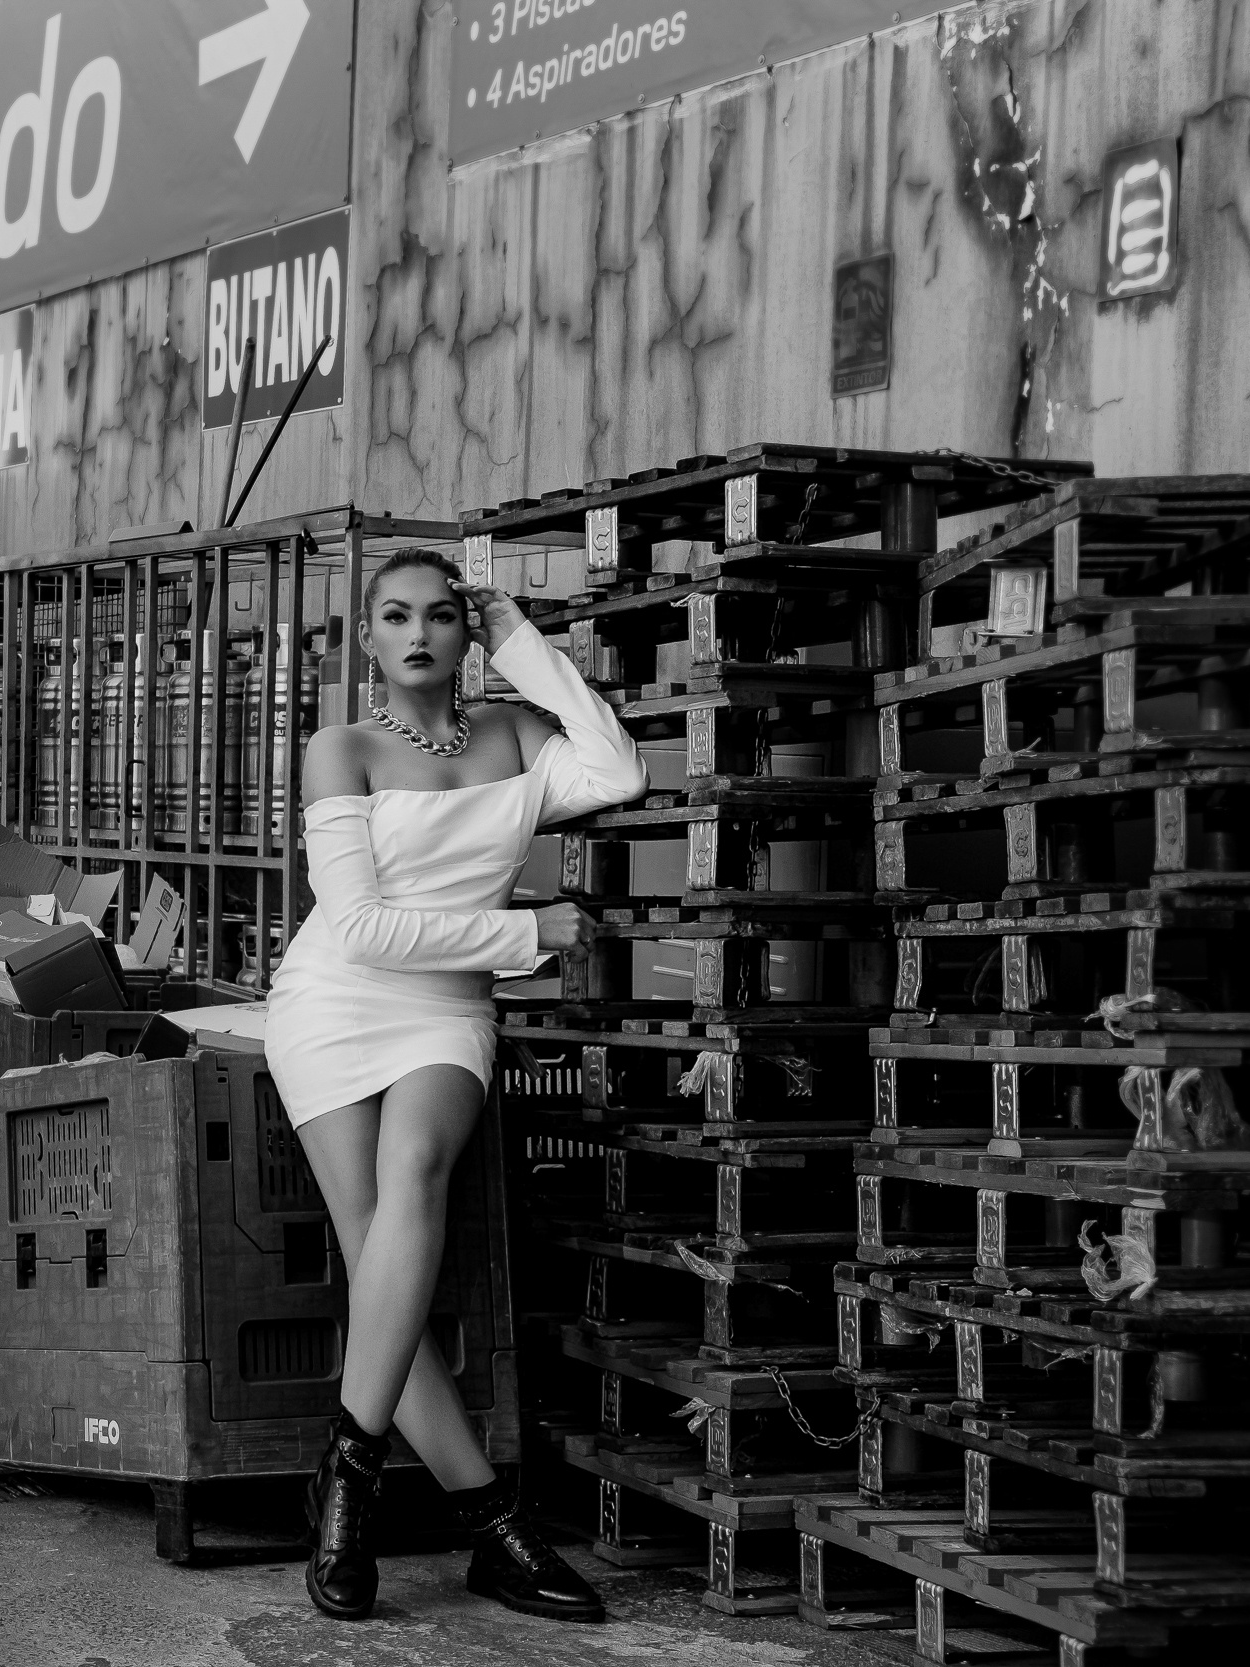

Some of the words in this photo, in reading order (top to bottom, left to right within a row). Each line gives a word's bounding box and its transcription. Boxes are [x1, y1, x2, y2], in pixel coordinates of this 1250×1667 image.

[488, 1, 506, 44] 3
[486, 68, 503, 109] 4
[506, 10, 688, 103] Aspiradores
[208, 246, 341, 398] BUTANO
[84, 1417, 120, 1445] IFCO
